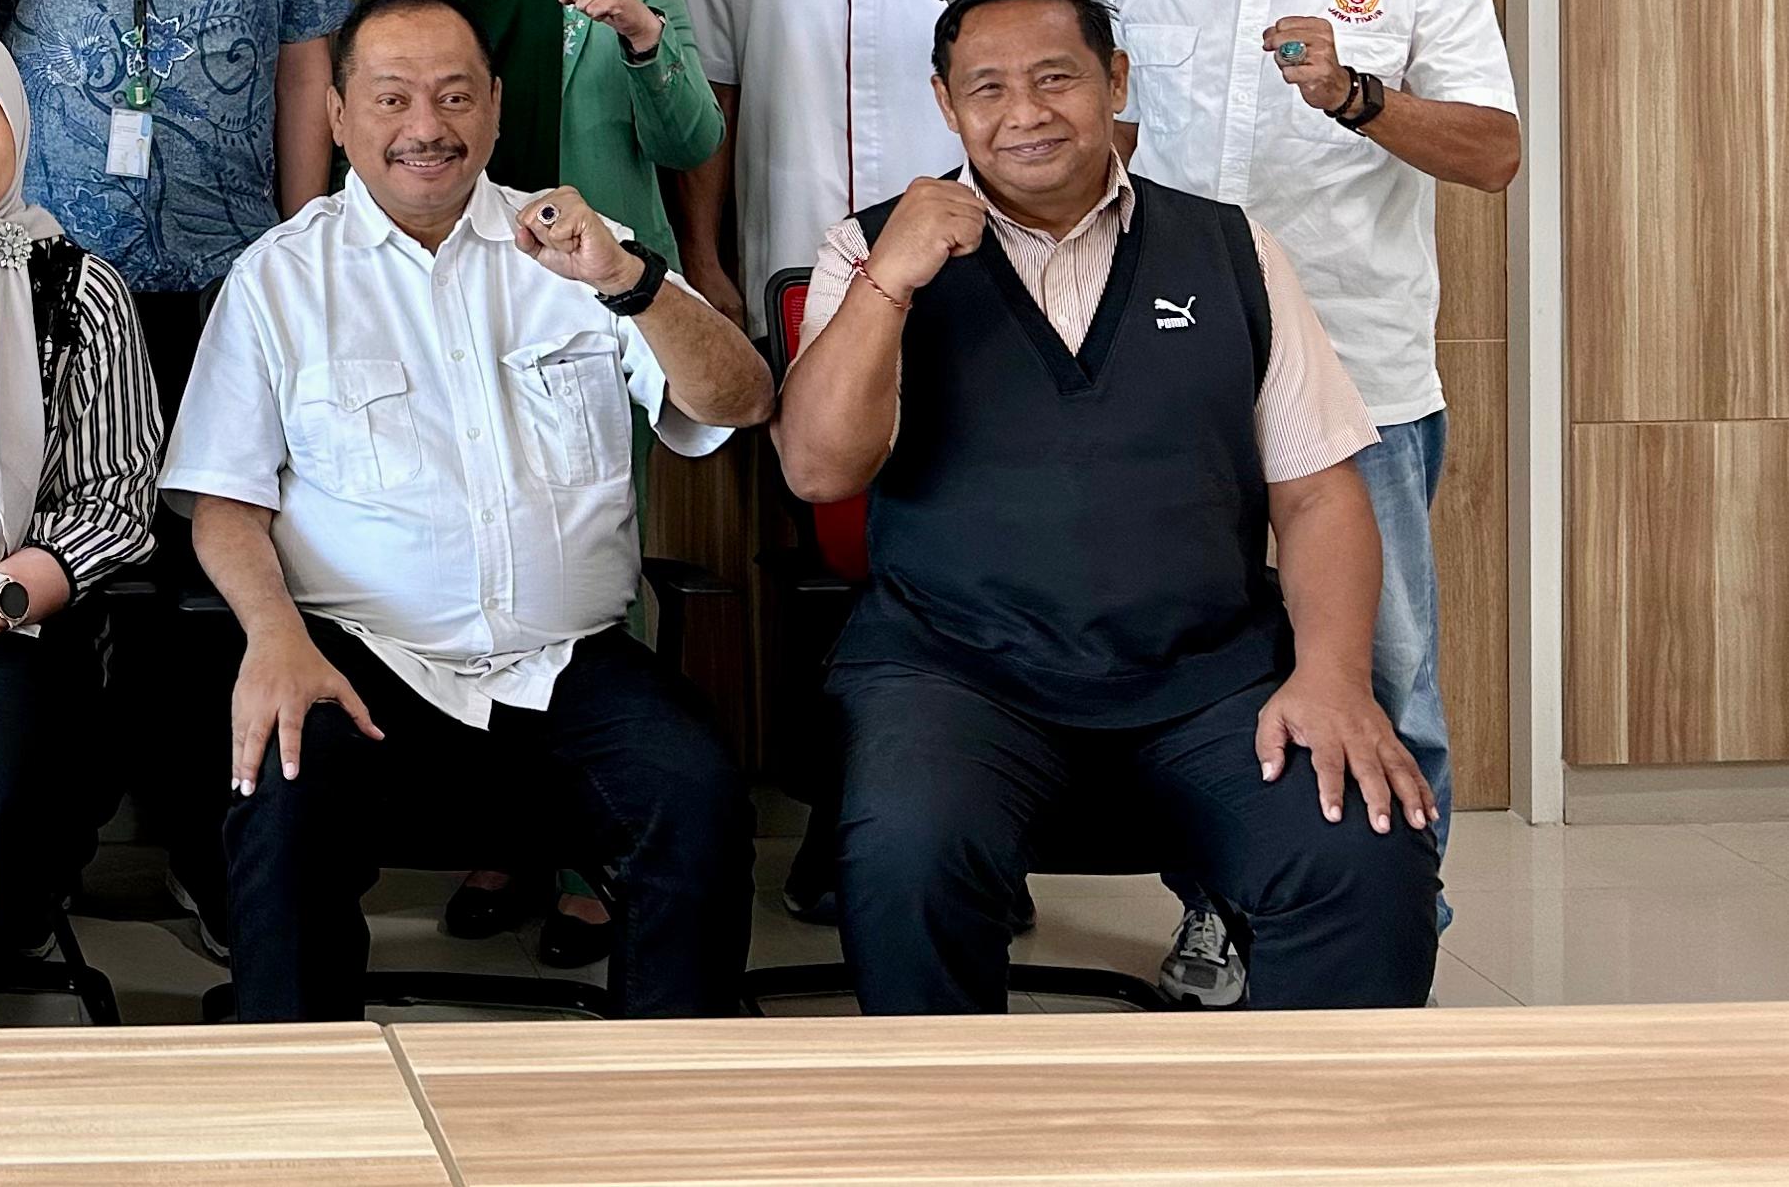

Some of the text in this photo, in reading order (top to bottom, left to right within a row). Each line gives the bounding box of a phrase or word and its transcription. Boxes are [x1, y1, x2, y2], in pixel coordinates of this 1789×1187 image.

[1328, 7, 1384, 24] JAWA TIMUR
[1156, 317, 1189, 329] PUMA
